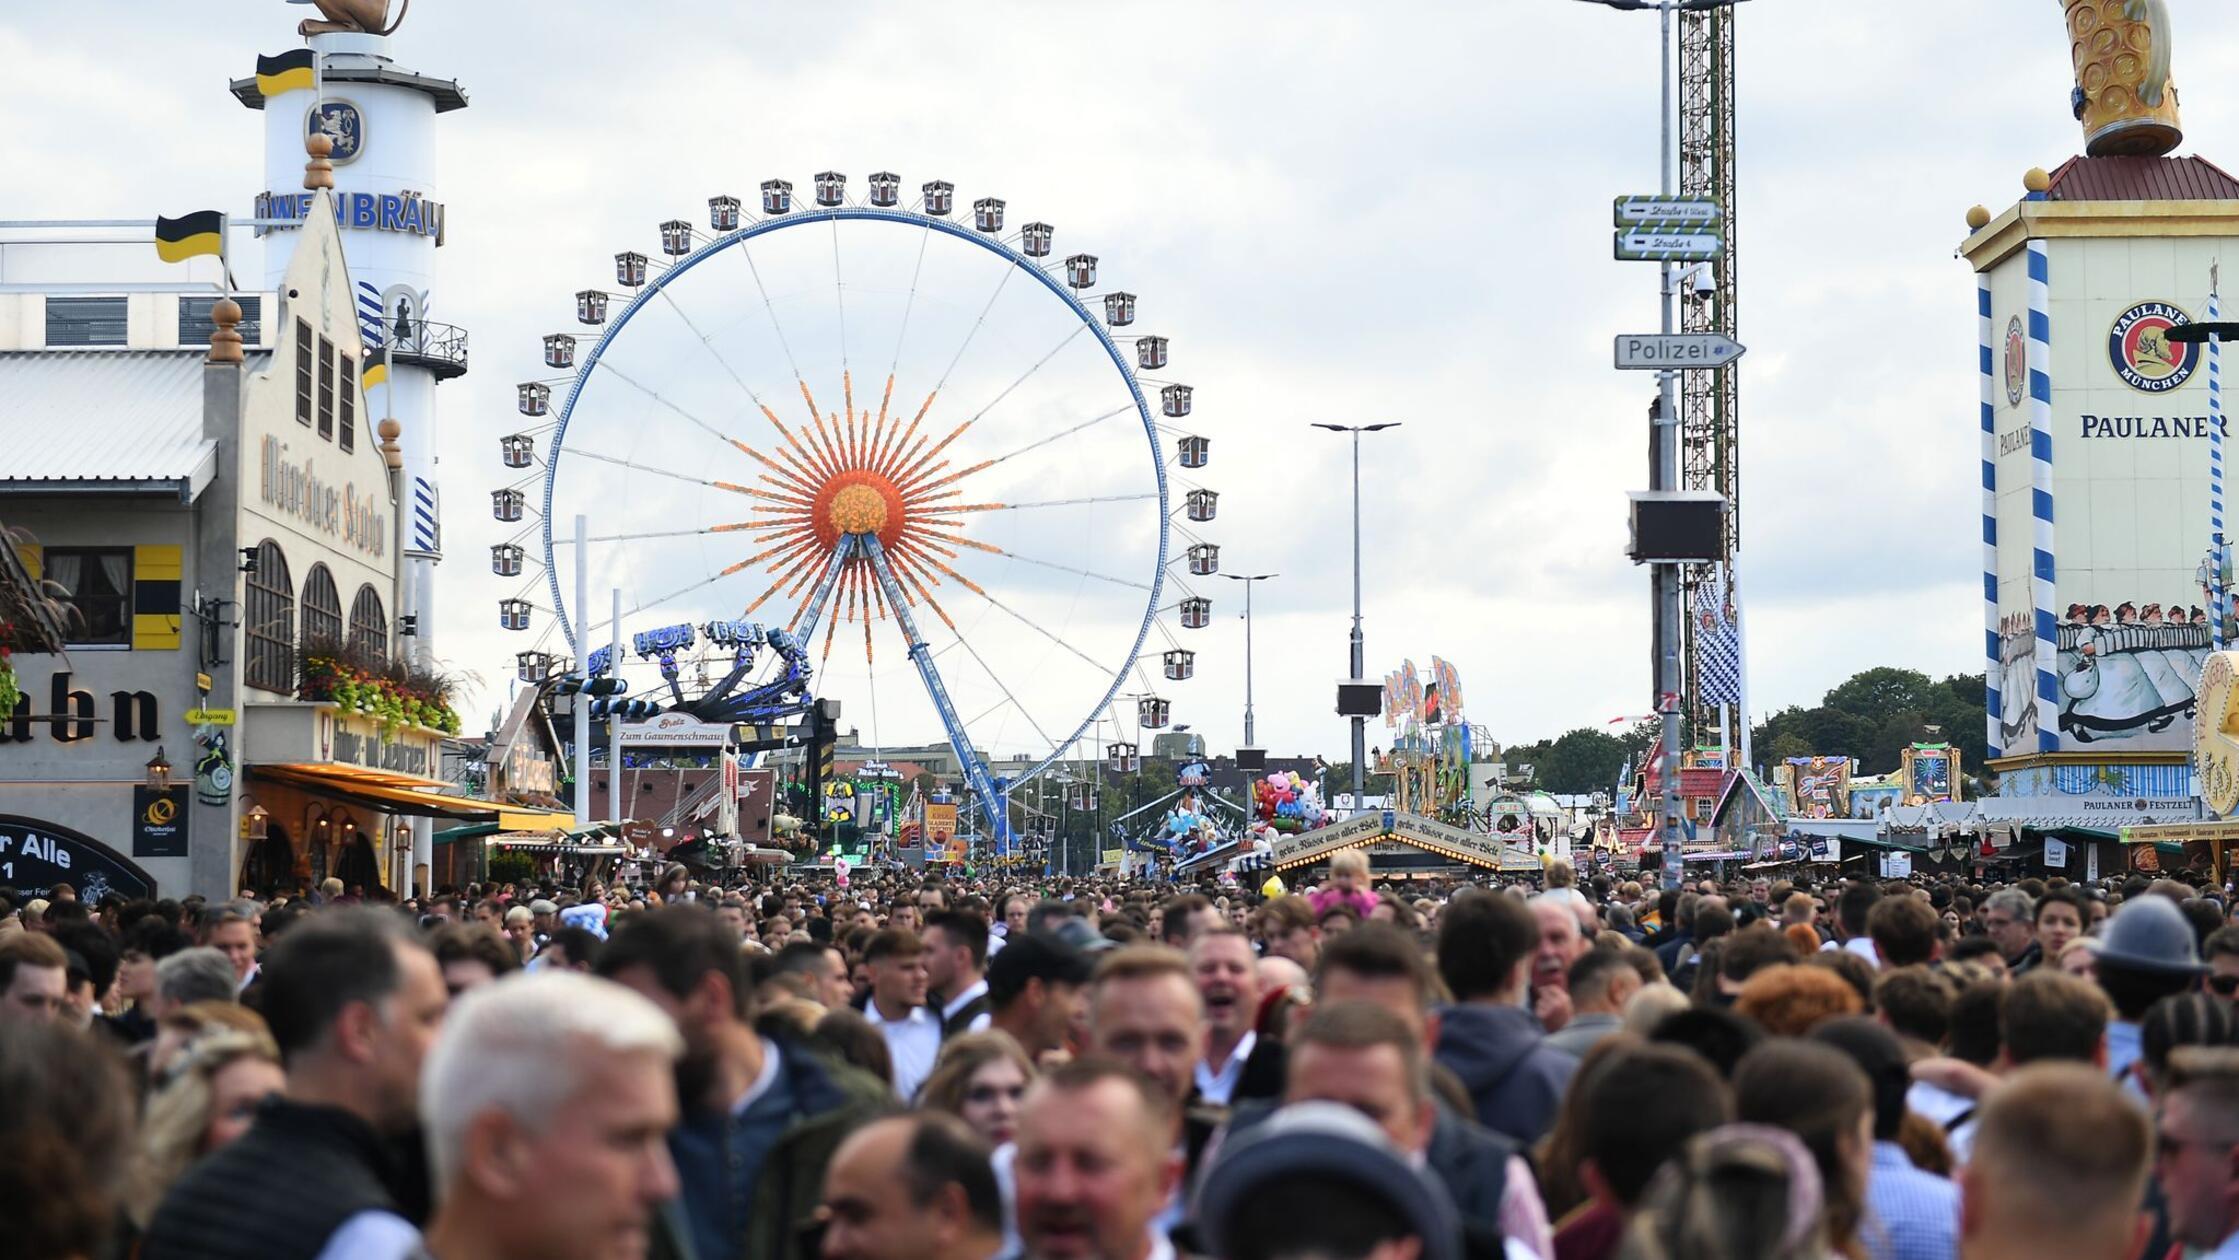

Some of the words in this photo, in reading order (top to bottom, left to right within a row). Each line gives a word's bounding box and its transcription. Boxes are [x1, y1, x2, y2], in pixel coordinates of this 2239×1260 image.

[2112, 303, 2191, 337] PAULANE
[1629, 340, 1708, 360] Polizei
[2120, 367, 2190, 391] MÜNCHEN
[619, 731, 642, 741] Zum
[644, 731, 724, 742] Gaumenschmaus
[2083, 800, 2133, 810] PAULANER
[2149, 800, 2192, 810] FESTZELT
[1341, 825, 1358, 837] aller
[21, 833, 71, 869] Alle
